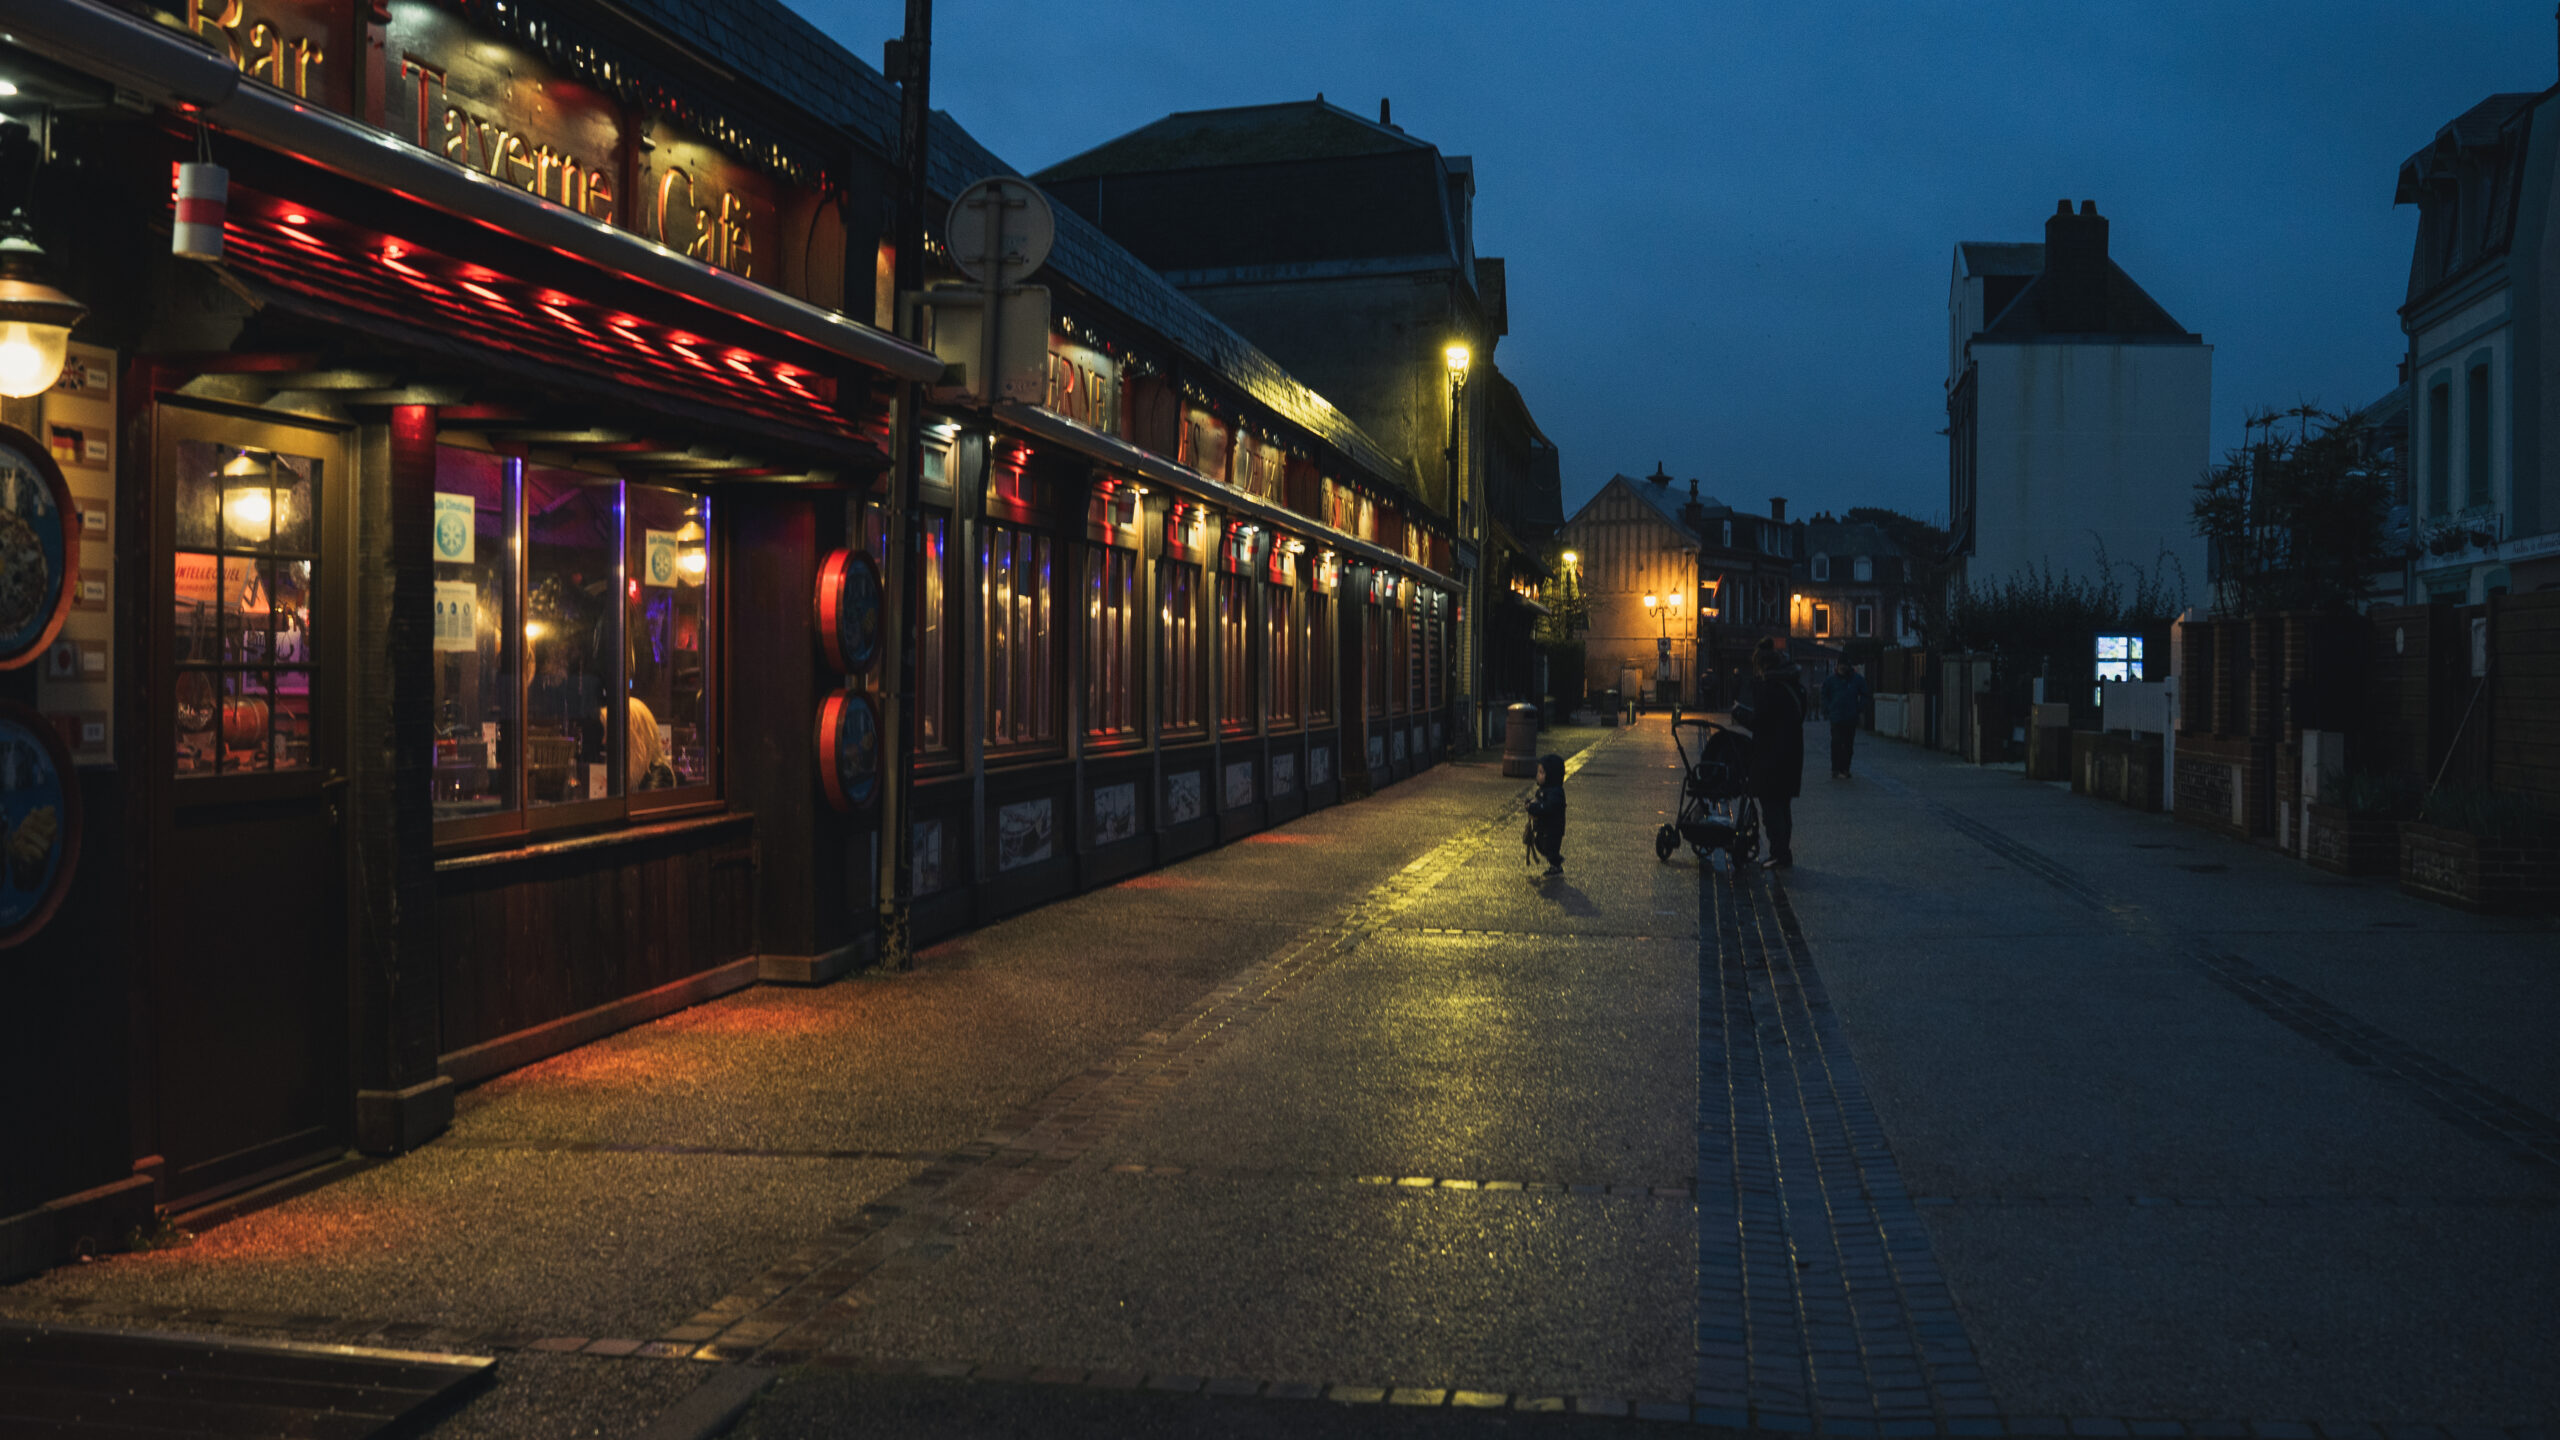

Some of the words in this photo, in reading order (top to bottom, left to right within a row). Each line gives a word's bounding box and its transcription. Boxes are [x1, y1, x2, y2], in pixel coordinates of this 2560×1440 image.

[188, 0, 324, 98] Bar
[402, 50, 614, 226] Taverne
[657, 166, 752, 279] Café
[1047, 350, 1108, 433] ERNE
